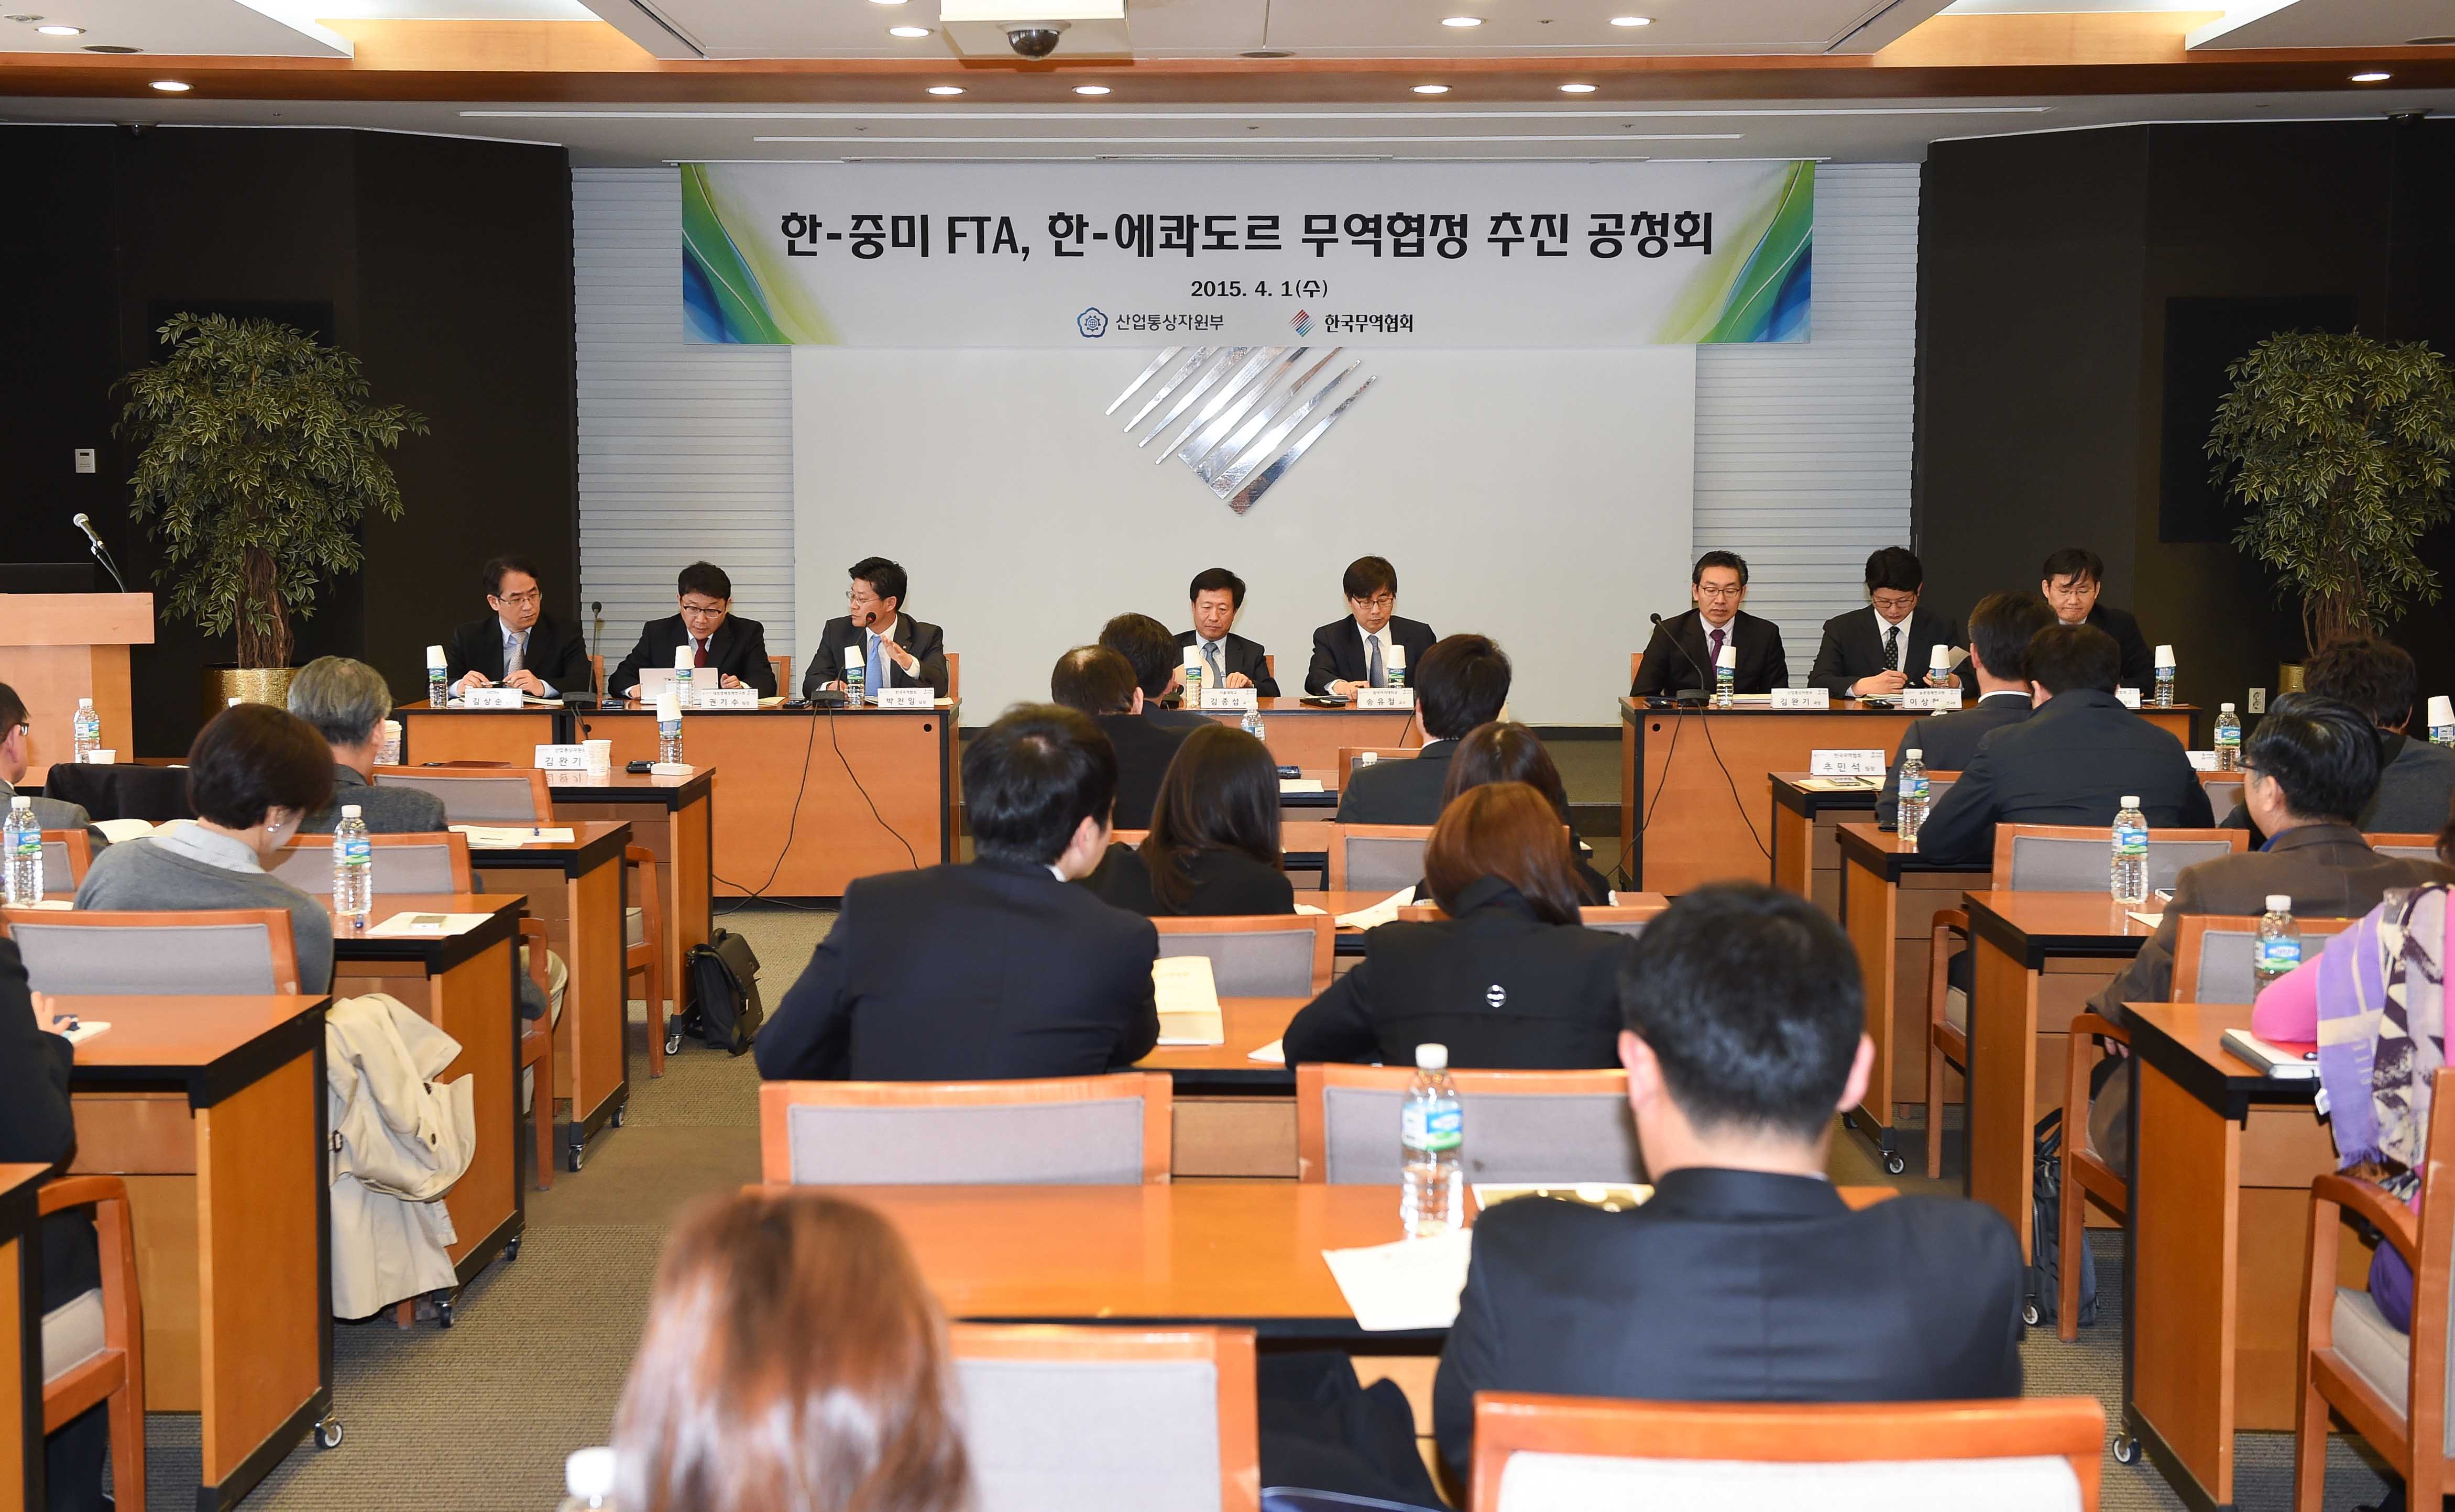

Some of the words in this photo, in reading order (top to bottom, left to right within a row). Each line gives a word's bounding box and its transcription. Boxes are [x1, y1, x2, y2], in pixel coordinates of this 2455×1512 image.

[781, 212, 929, 259] 한-중미
[948, 216, 1029, 262] FTA,
[1048, 212, 1282, 258] 한-에콰도르
[1301, 212, 1468, 259] 무역협정
[1487, 212, 1568, 257] 추진
[1587, 211, 1712, 259] 공청회
[1191, 280, 1247, 297] 2015.
[1254, 280, 1272, 297] 4.
[1281, 279, 1328, 298] 1(수)
[1116, 314, 1224, 331] 산업통상자원부
[1325, 314, 1413, 333] 한국무역협회
[545, 757, 582, 766] 김완기
